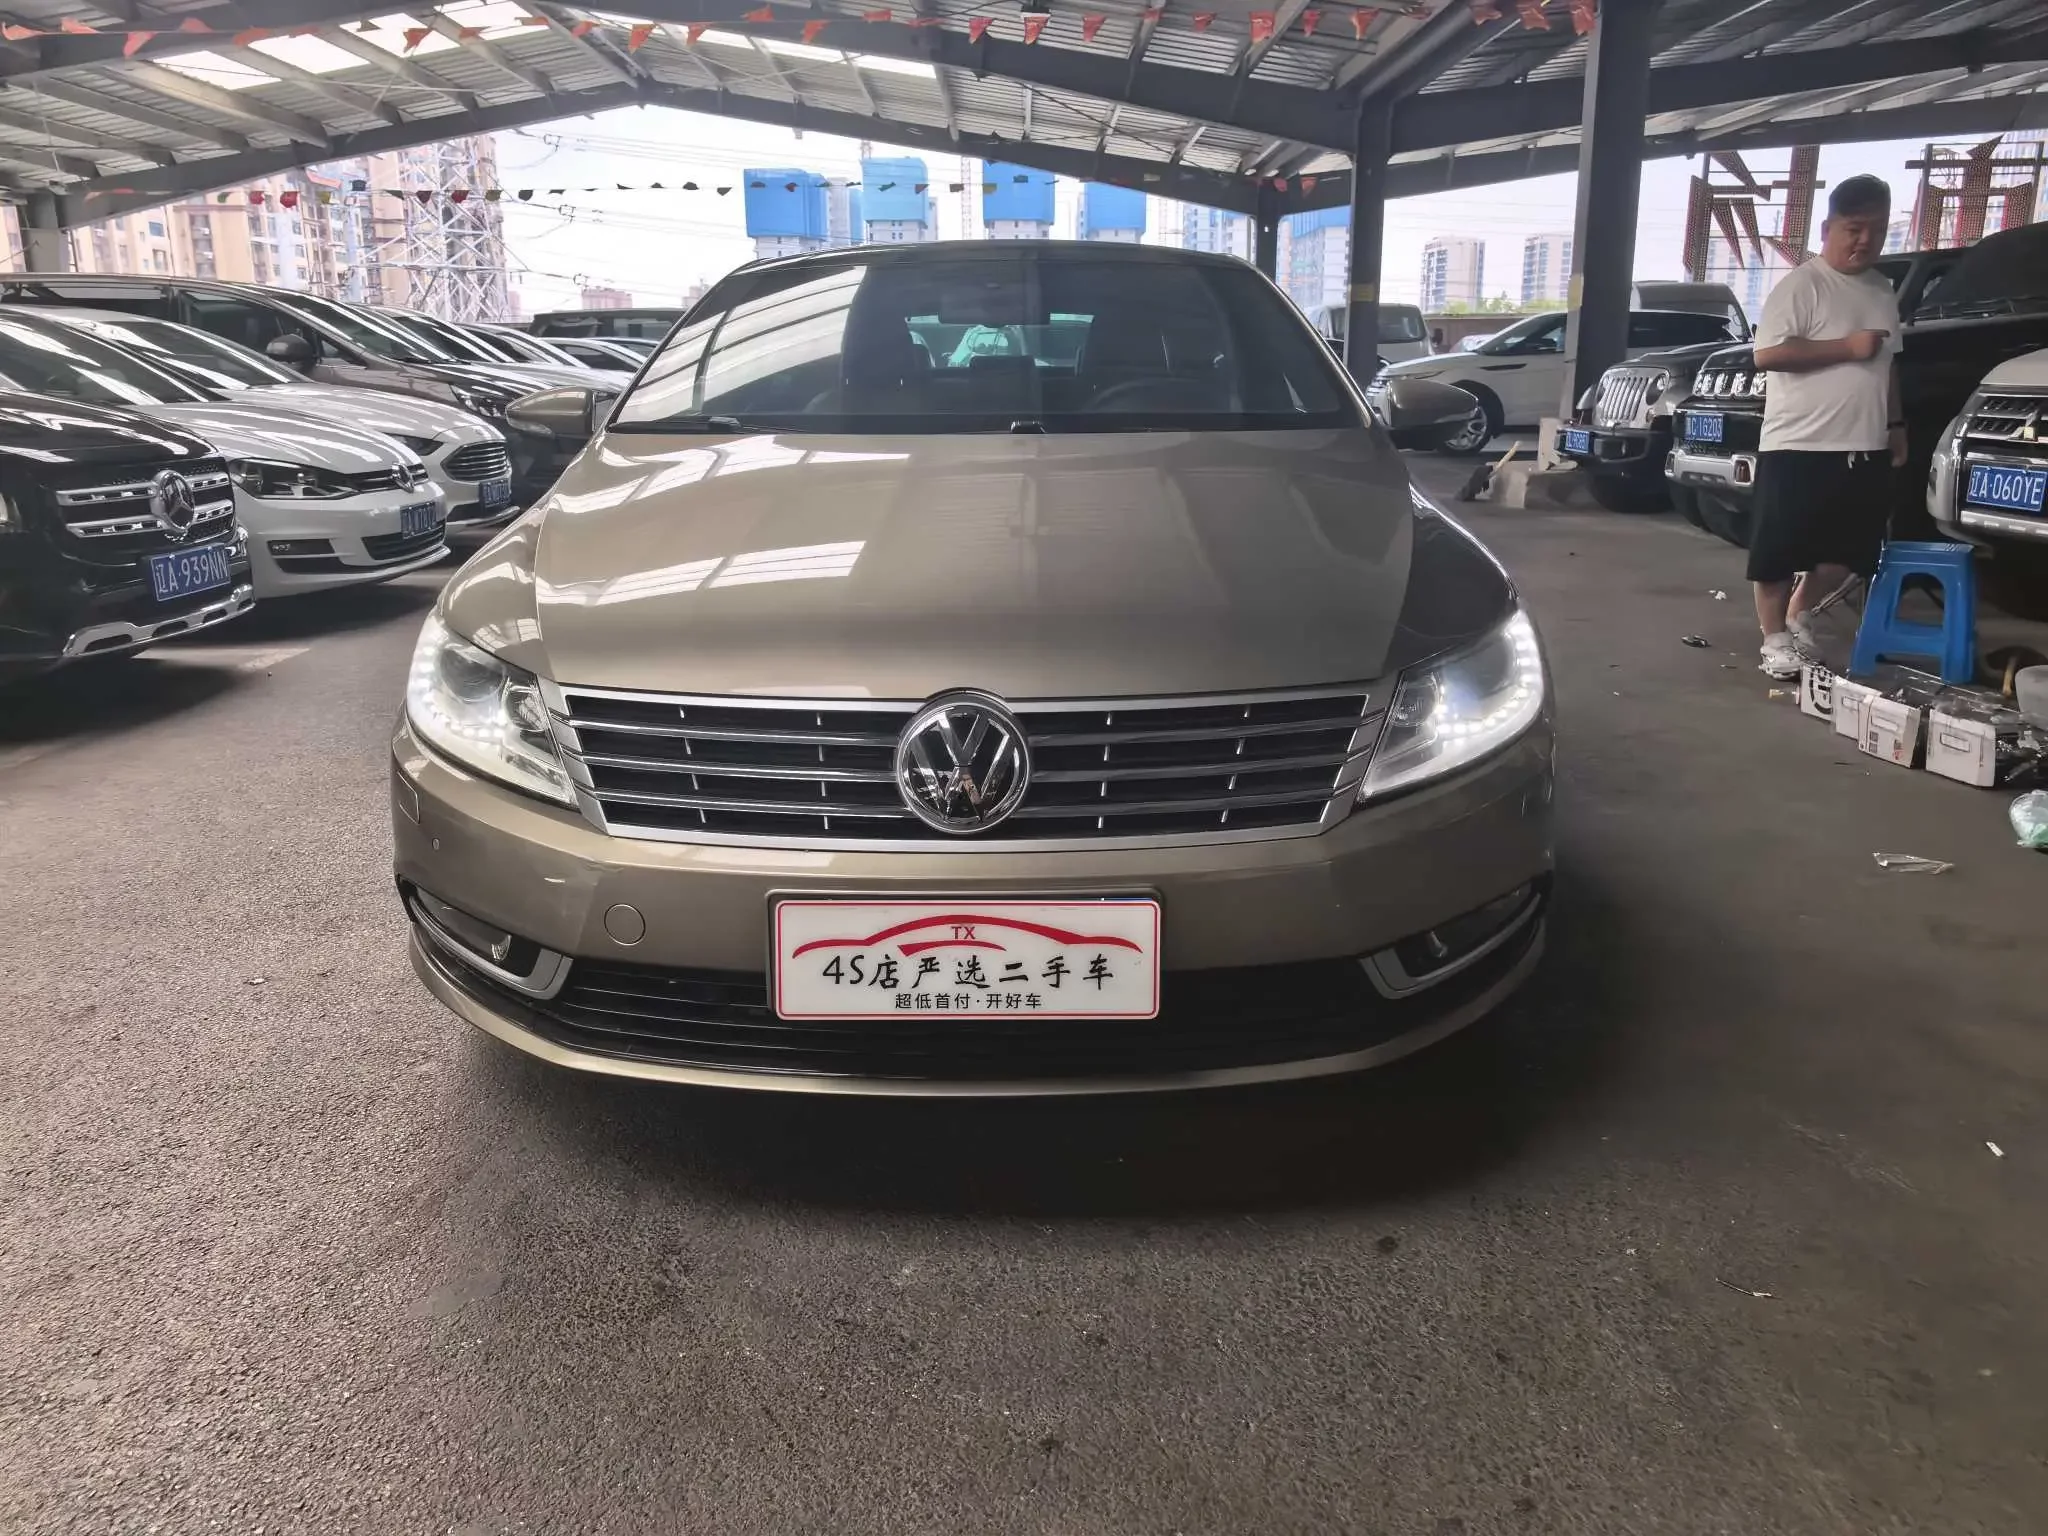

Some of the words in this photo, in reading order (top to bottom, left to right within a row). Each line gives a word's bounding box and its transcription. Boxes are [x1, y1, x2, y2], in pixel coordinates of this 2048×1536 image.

[951, 926, 976, 940] TX
[822, 953, 1113, 990] 4S店严选二手车
